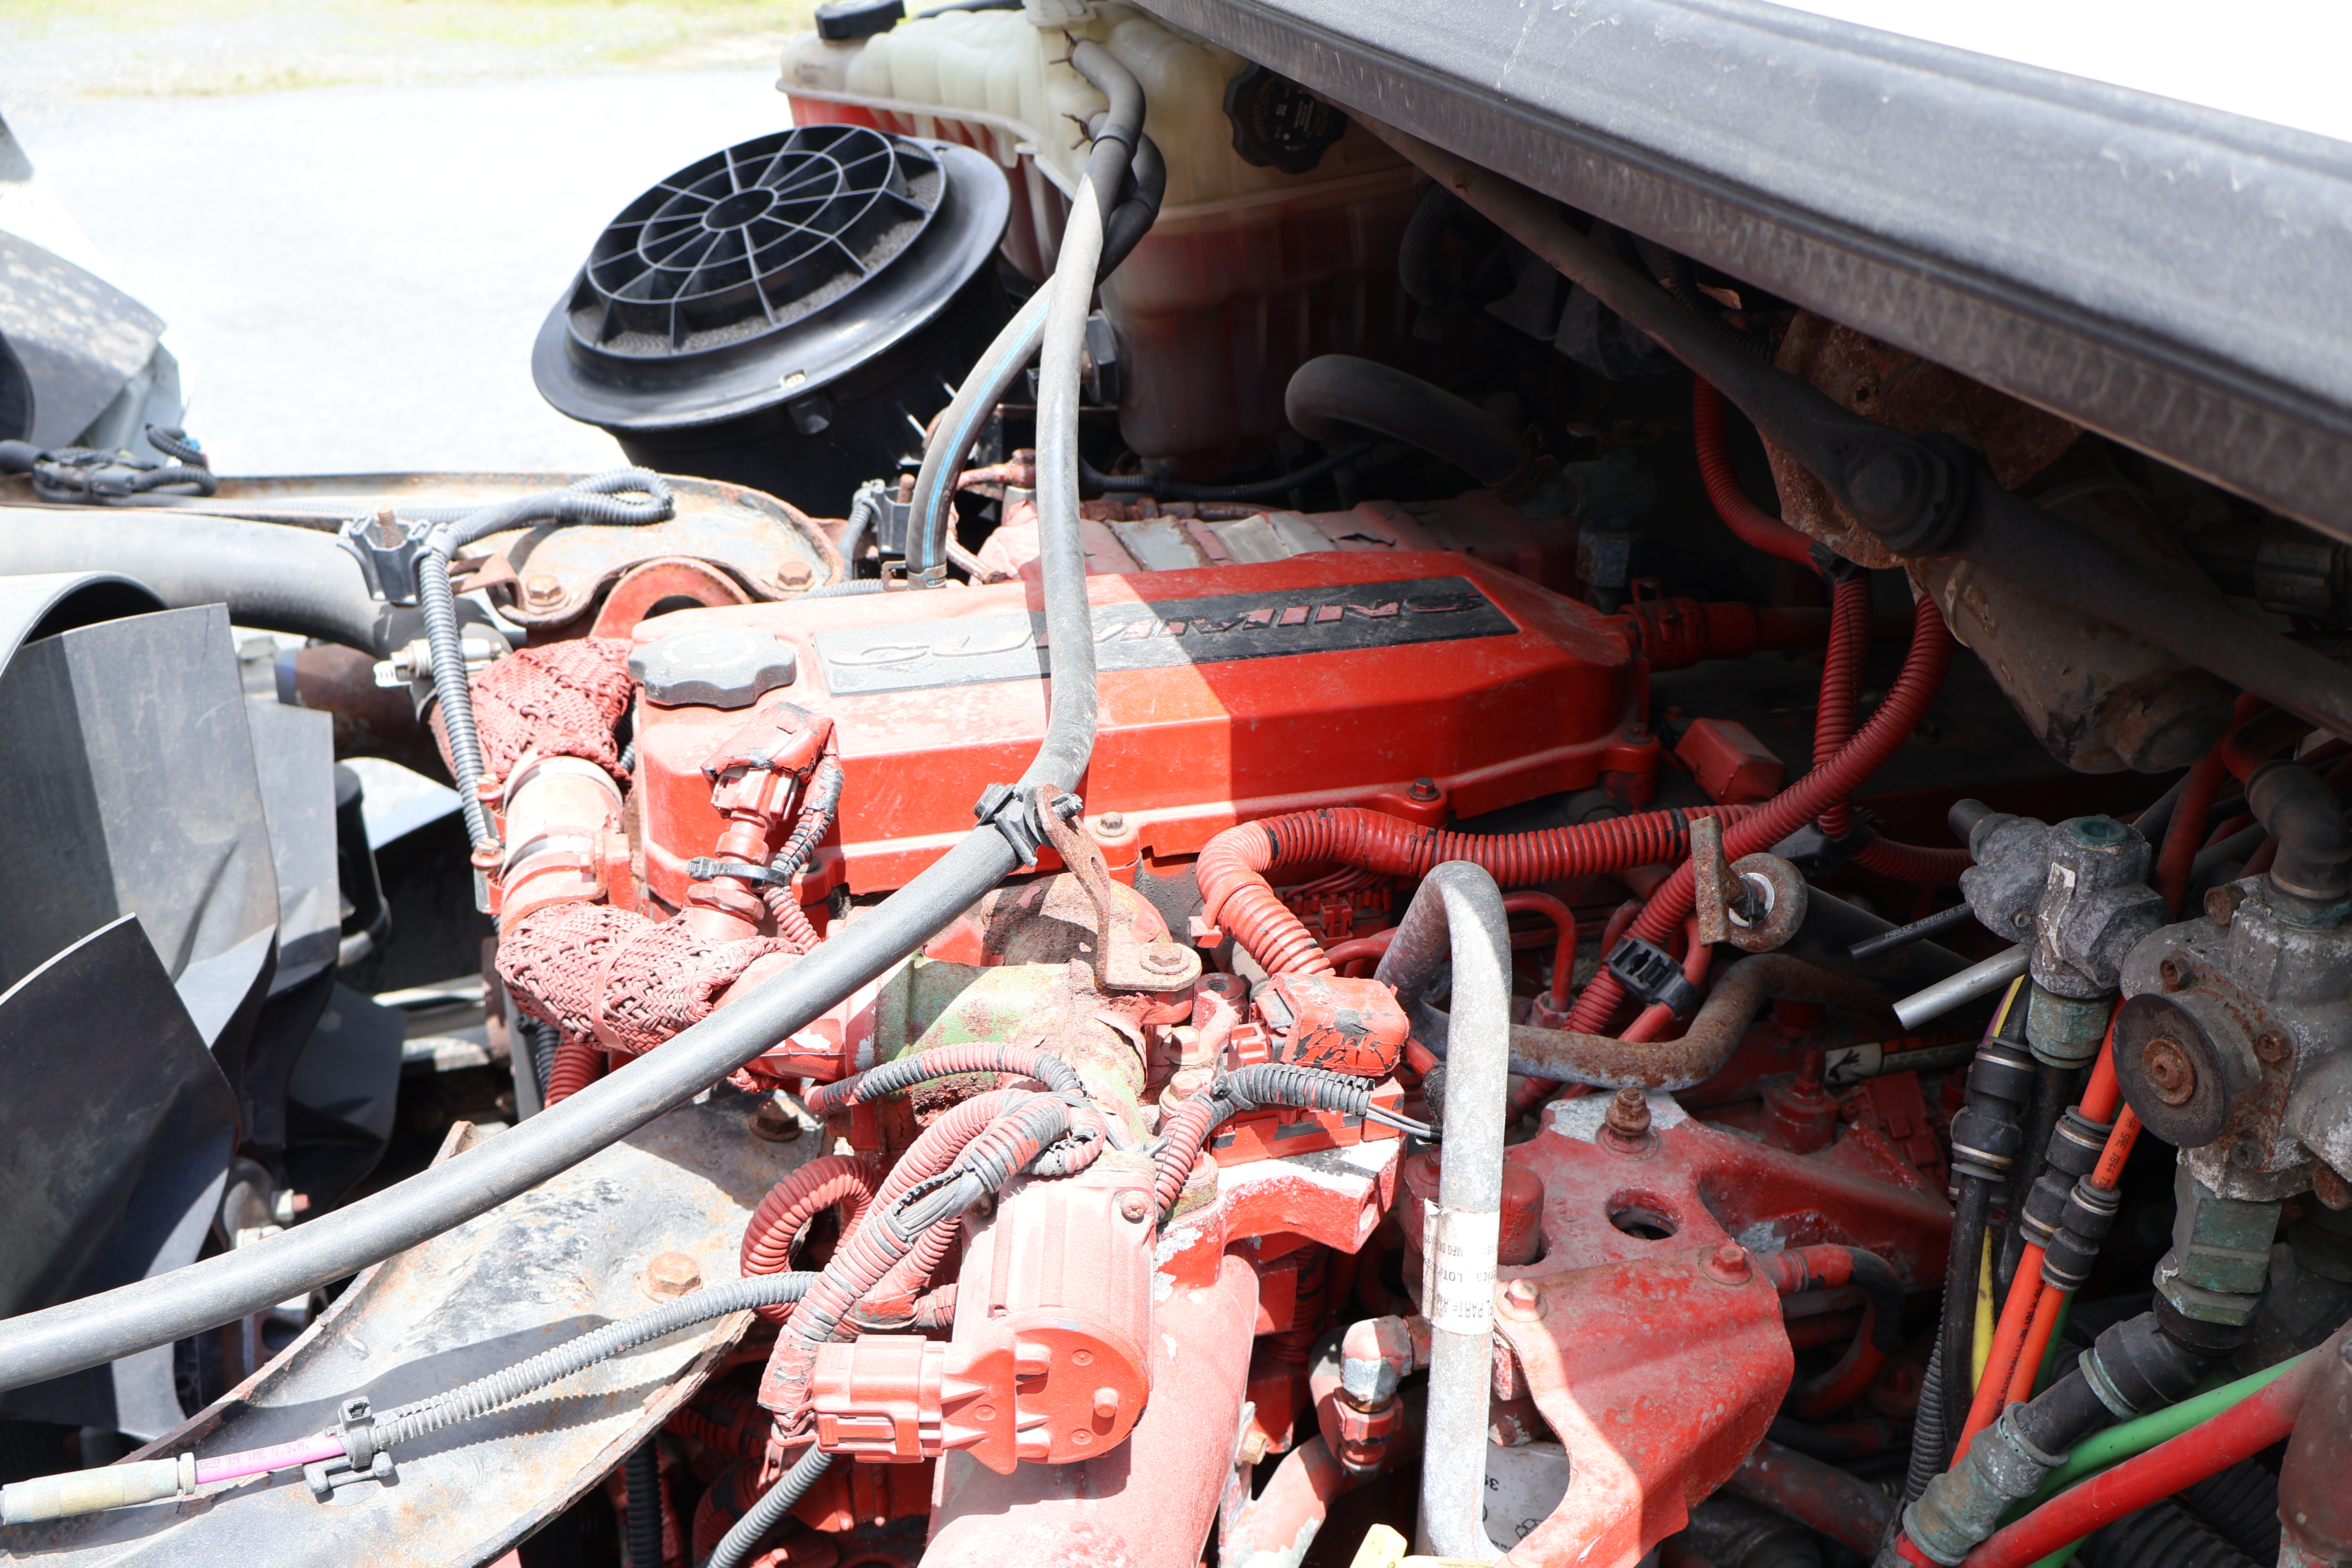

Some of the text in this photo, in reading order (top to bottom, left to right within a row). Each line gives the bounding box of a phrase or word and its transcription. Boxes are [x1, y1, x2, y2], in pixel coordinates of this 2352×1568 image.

[1884, 924, 1913, 939] PARKER
[1958, 902, 1969, 913] CO
[2115, 1131, 2131, 1151] SAE
[1448, 1245, 1463, 1257] MFG
[227, 1453, 241, 1466] IN
[247, 1448, 267, 1462] THE
[271, 1441, 310, 1456] U.S.A.
